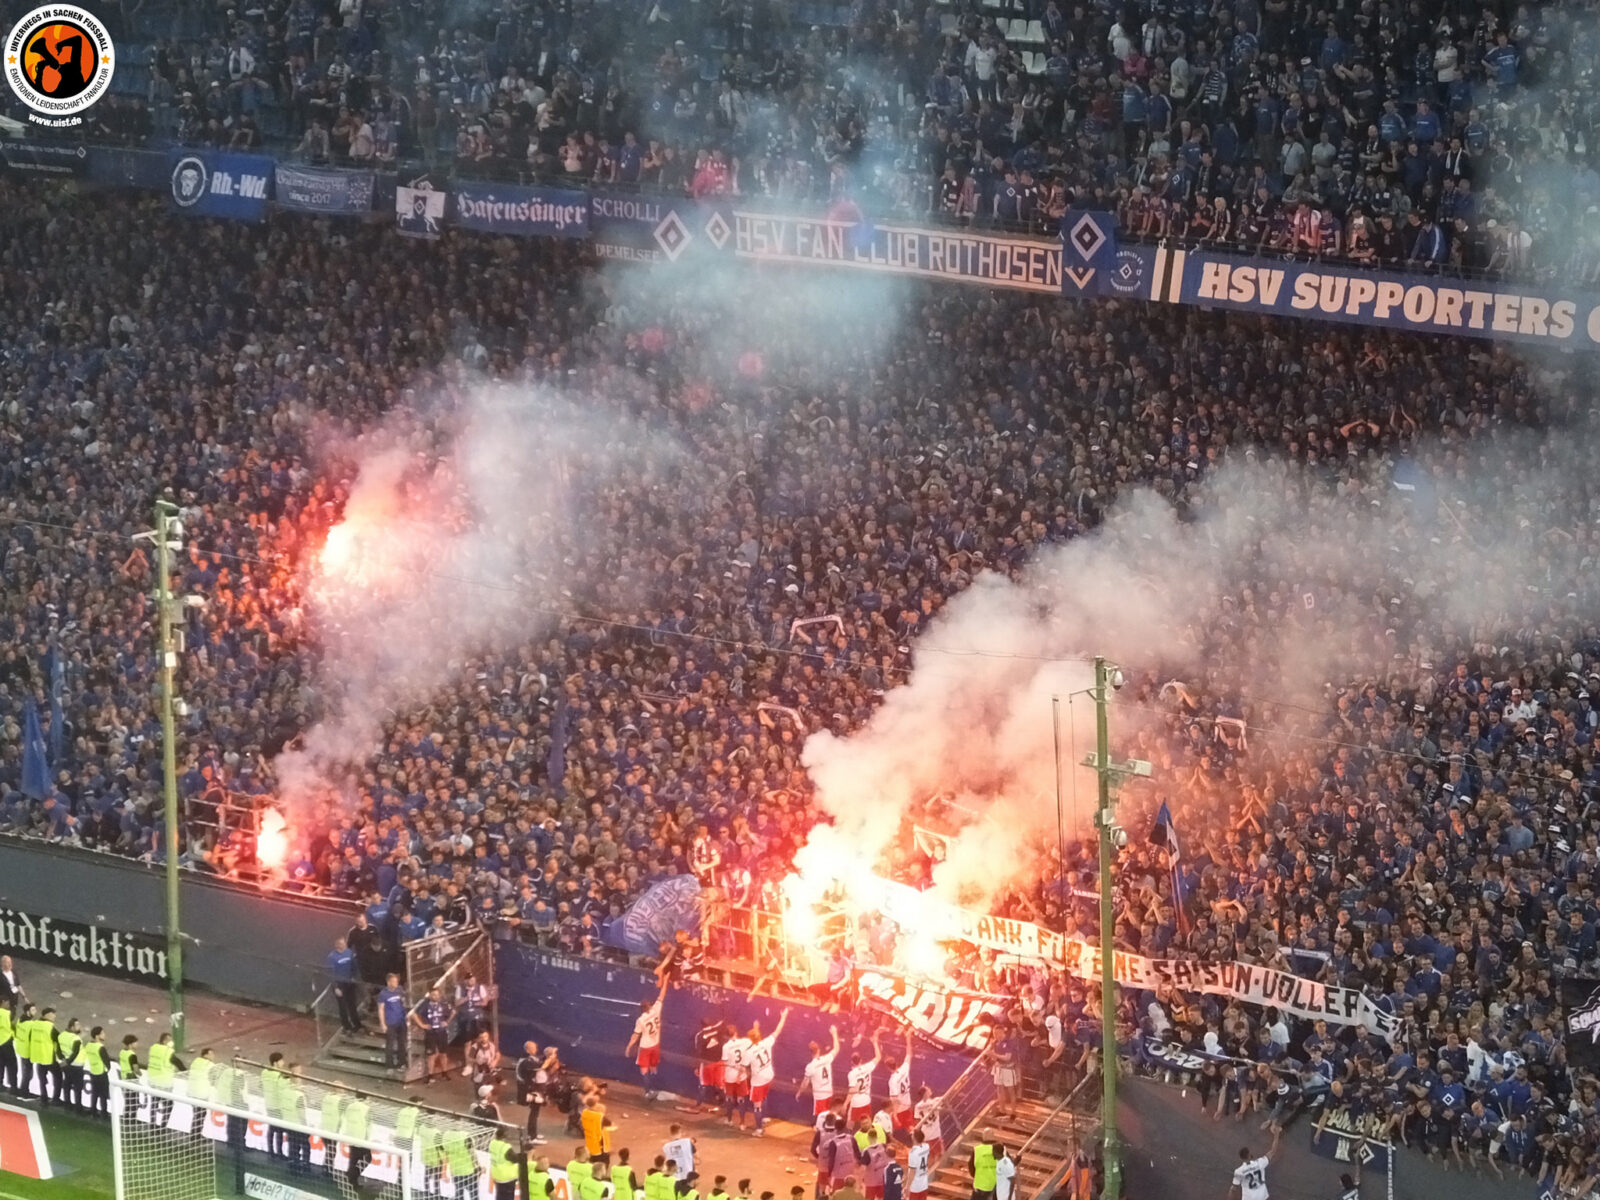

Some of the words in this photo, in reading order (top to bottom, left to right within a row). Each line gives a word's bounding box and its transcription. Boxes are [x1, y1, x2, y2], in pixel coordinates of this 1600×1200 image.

[210, 171, 267, 199] Rh.-Wd.
[457, 192, 586, 230] Hafensänger
[735, 216, 787, 255] HSV
[797, 223, 844, 260] FAN
[928, 236, 1063, 285] ROTHOSEN
[1198, 261, 1285, 305] HSV
[1291, 272, 1576, 338] SUPPORTERS
[0, 908, 168, 978] üdfraktion
[1093, 949, 1143, 980] ENE
[734, 1049, 742, 1063] 3
[1245, 1169, 1265, 1189] 27
